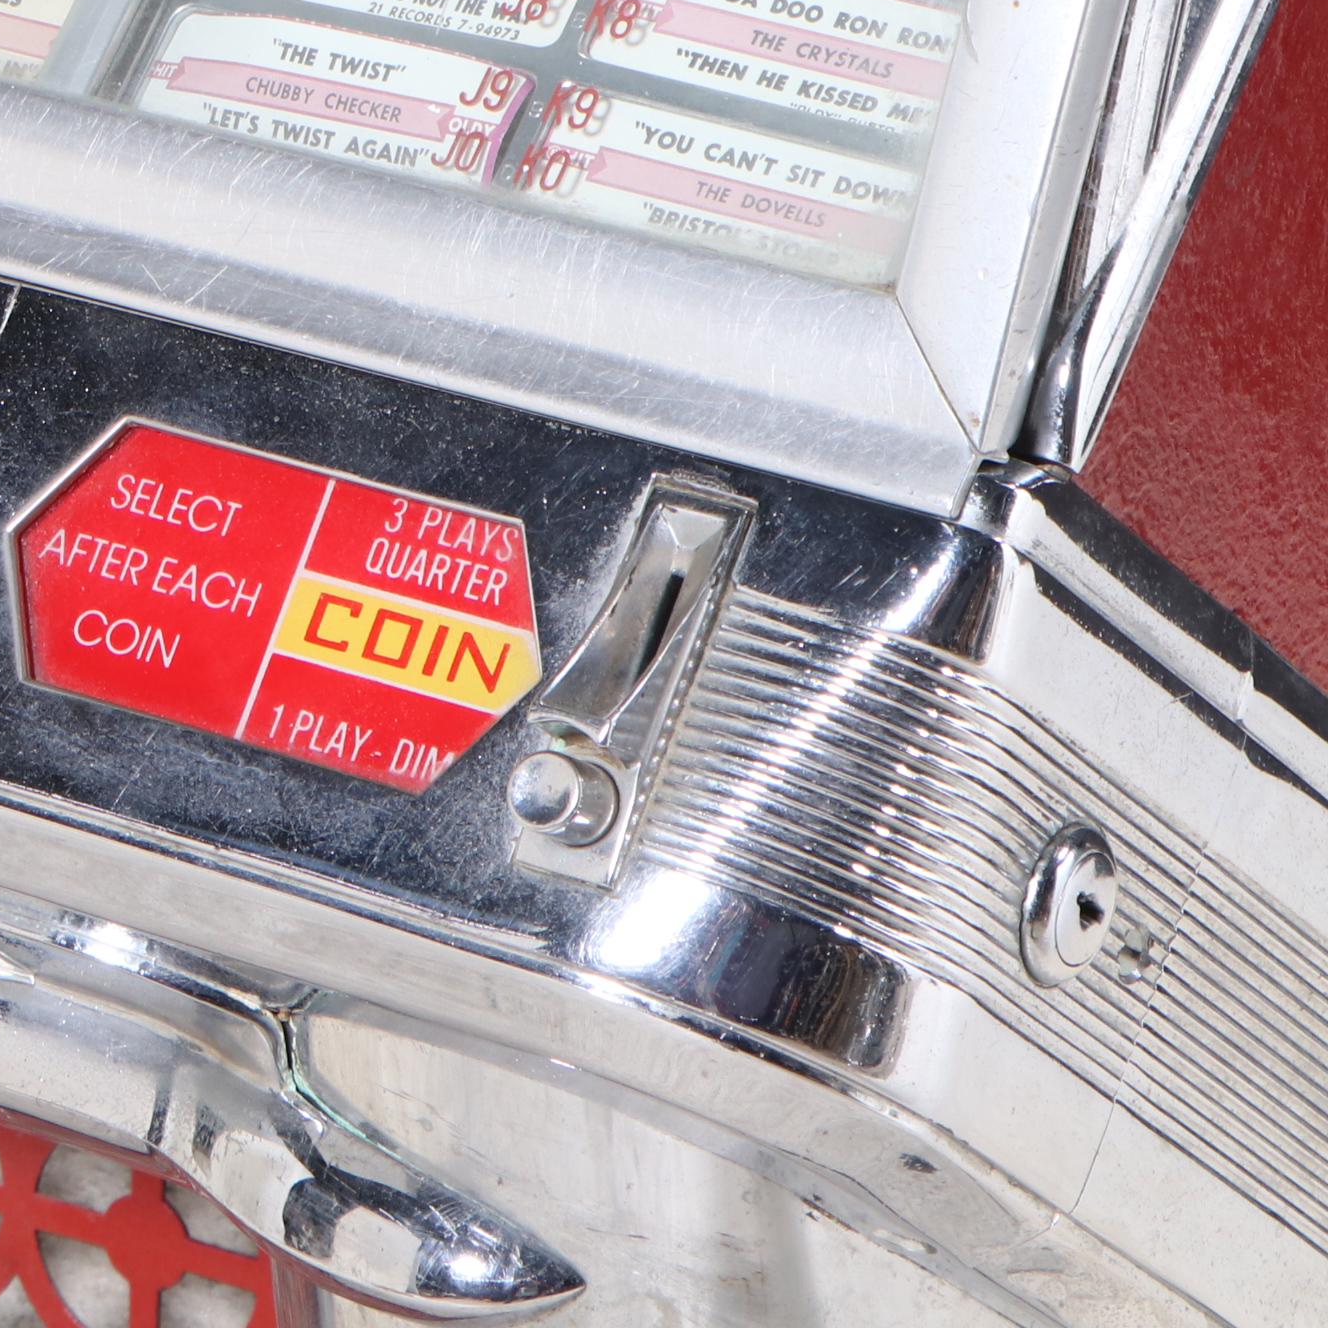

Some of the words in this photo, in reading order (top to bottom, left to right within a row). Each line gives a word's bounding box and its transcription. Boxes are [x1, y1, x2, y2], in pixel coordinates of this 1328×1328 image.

[111, 475, 242, 536] SELECT
[385, 498, 408, 532] 3
[418, 506, 519, 562] PLAYS
[38, 528, 148, 585] AFTER
[152, 557, 262, 617] EACH
[366, 538, 507, 605] QUARTER
[74, 610, 180, 668] COIN
[304, 592, 510, 693] COIN
[269, 704, 284, 738] 1
[289, 710, 374, 761] PLAY
